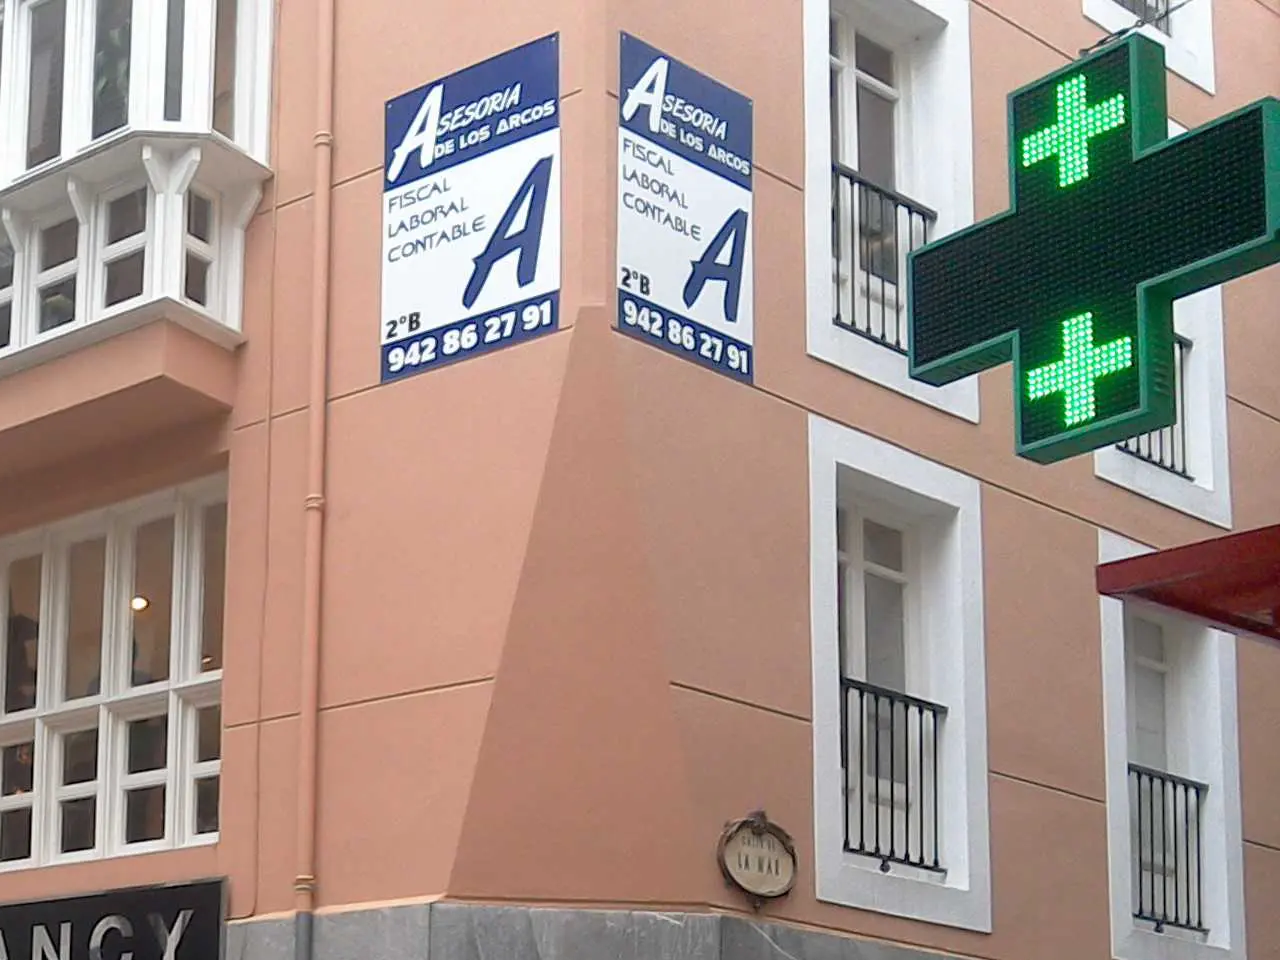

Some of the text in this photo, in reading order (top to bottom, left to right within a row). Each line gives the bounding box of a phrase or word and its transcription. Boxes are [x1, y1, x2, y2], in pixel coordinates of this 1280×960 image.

[435, 100, 556, 160] DE LOS ARCOS
[660, 118, 751, 176] DE LOS ARCOS
[623, 138, 675, 176] FISCAL
[388, 178, 451, 214] FISCAL
[623, 164, 688, 209] LABORAL
[388, 197, 469, 239] LABORAL
[388, 215, 487, 263] CONTABLE
[623, 192, 702, 241] CONTABLE
[388, 300, 552, 372] 942 86 27 91
[623, 299, 749, 374] 942 86 27 91
